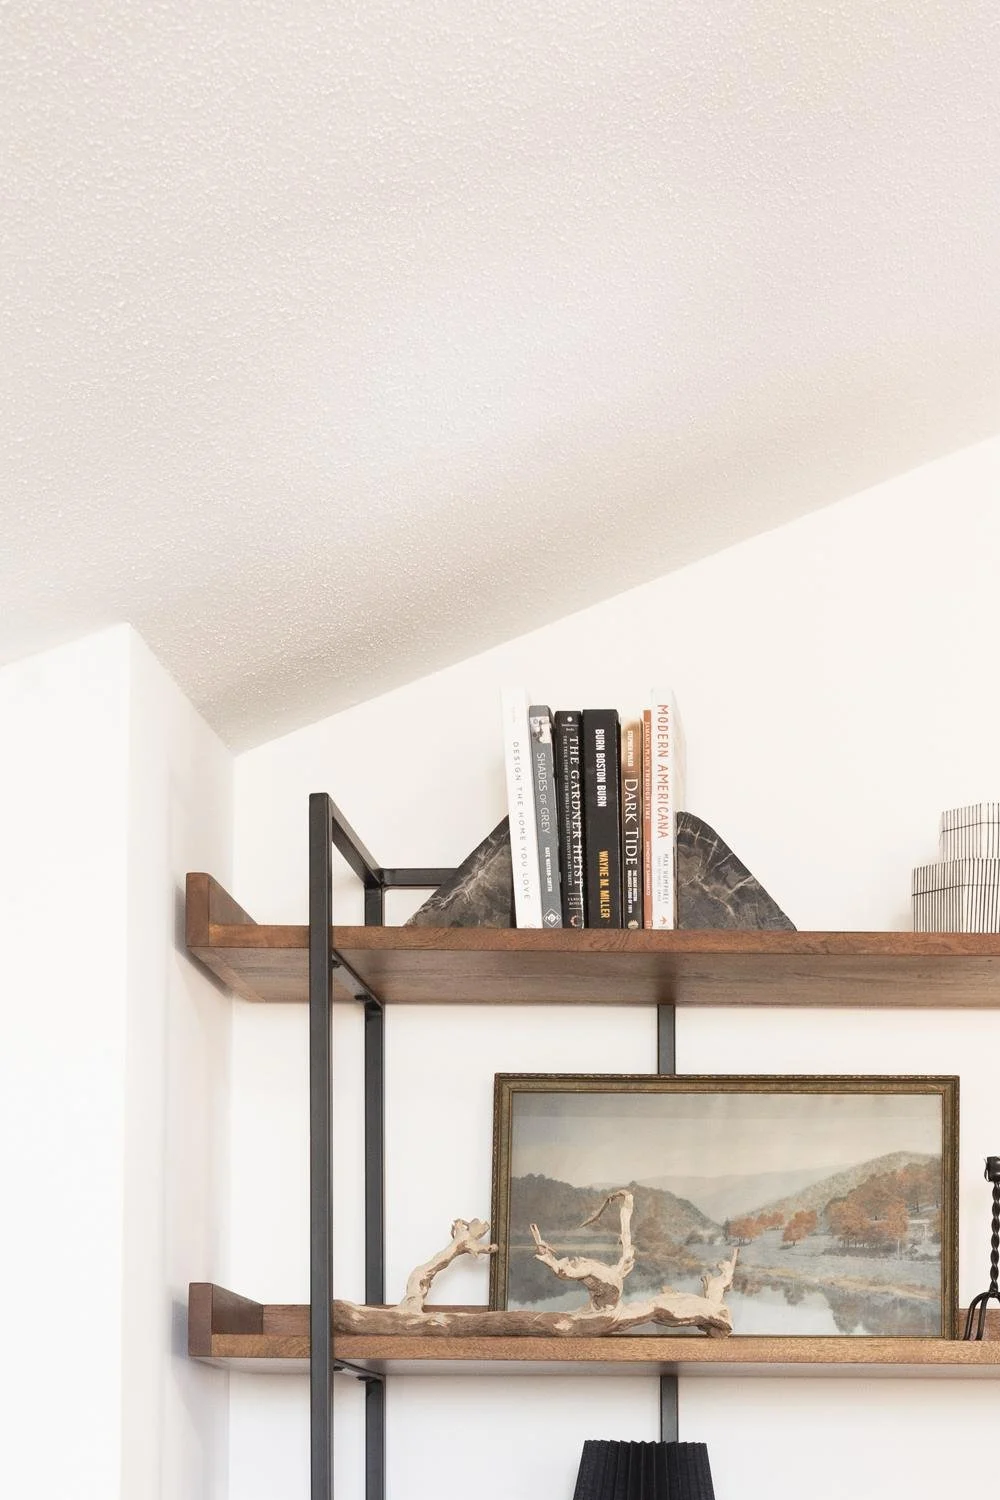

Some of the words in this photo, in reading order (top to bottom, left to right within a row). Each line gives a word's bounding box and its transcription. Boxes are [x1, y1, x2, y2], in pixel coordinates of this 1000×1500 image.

[595, 729, 605, 750] BURN
[657, 704, 669, 758] MODERN
[513, 741, 522, 782] DESIGN
[569, 736, 580, 765] THE
[536, 752, 548, 792] SHADES
[596, 753, 606, 782] BOSTON
[516, 787, 524, 807] THE
[540, 795, 547, 804] OF
[570, 769, 582, 840] GARDNER
[597, 785, 607, 807] BURN
[625, 778, 638, 824] DARK
[657, 764, 669, 839] AMERICANA
[518, 812, 527, 842] HOME
[540, 807, 550, 834] GREY
[521, 847, 529, 868] YOU
[625, 826, 639, 865] TIDE
[572, 844, 583, 886] HEIST
[599, 851, 609, 876] WAYNE
[523, 873, 531, 900] LOVE
[600, 878, 609, 888] M.
[600, 890, 611, 919] MILLER
